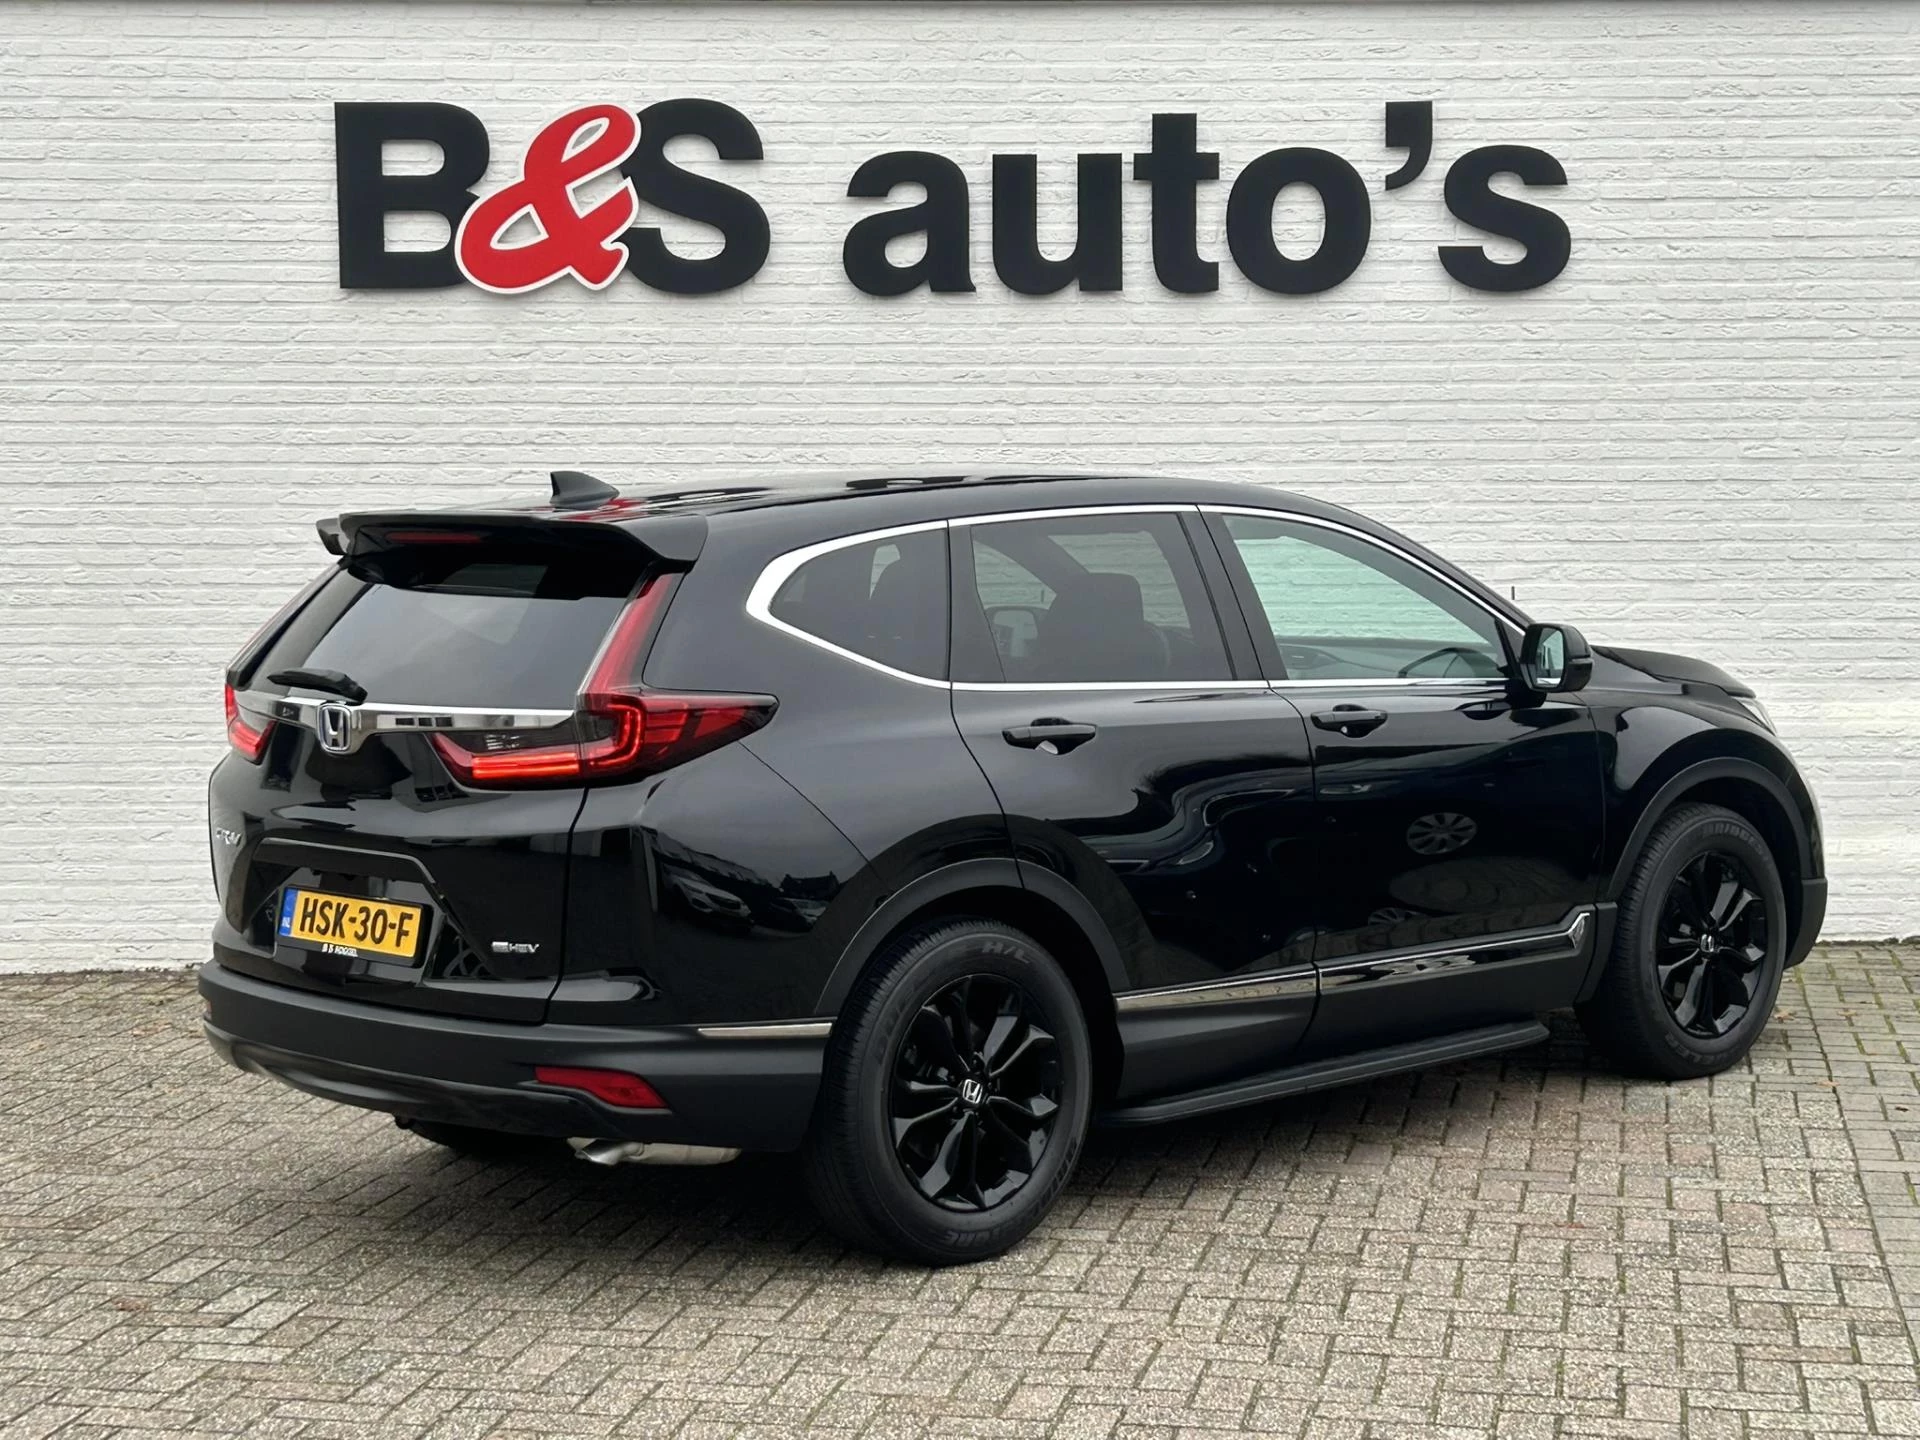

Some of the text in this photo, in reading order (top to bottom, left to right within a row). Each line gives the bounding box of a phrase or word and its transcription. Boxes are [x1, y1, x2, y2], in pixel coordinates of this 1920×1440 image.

[335, 98, 1572, 298] B&S auto's
[299, 897, 413, 947] HSK-30-F
